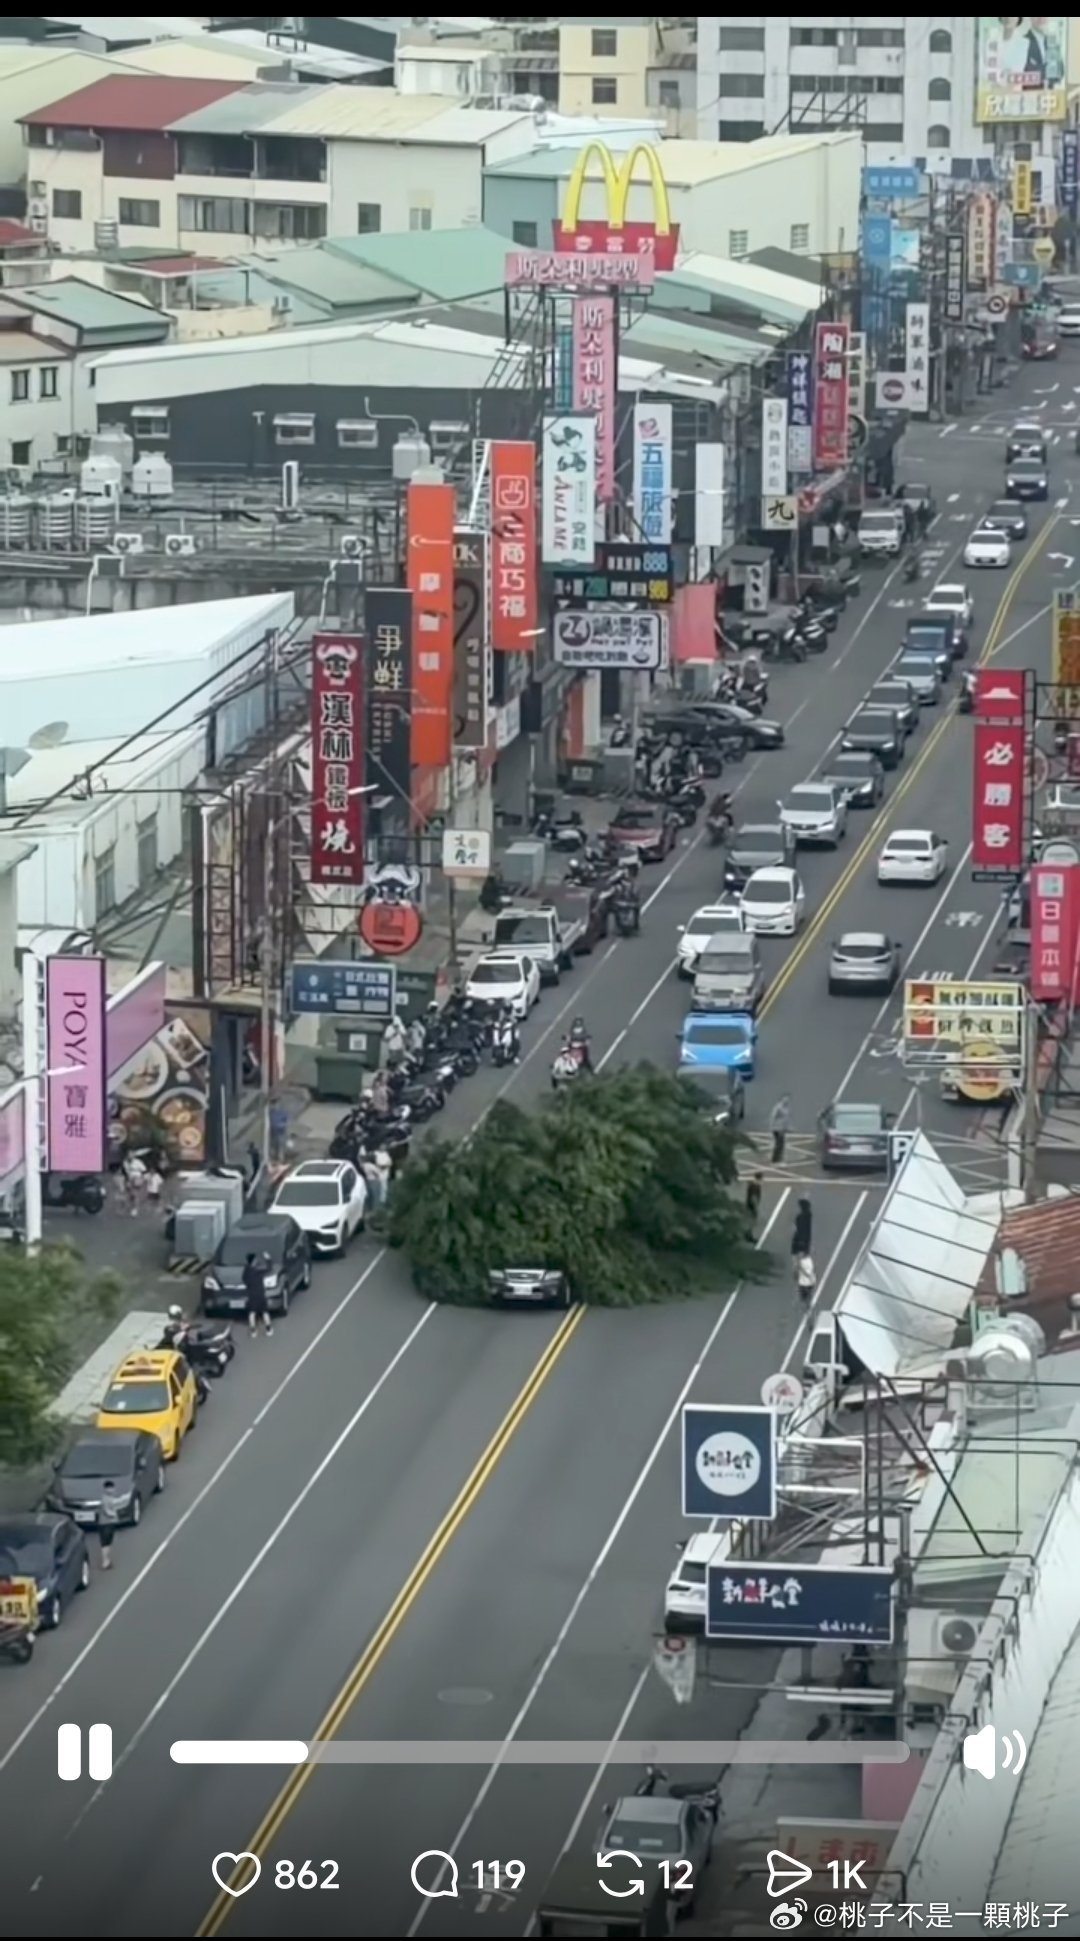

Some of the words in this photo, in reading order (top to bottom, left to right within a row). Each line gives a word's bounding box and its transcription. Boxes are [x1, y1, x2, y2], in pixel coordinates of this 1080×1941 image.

[373, 624, 403, 692] 爭鮮
[561, 617, 588, 639] 24
[62, 991, 88, 1068] POYA
